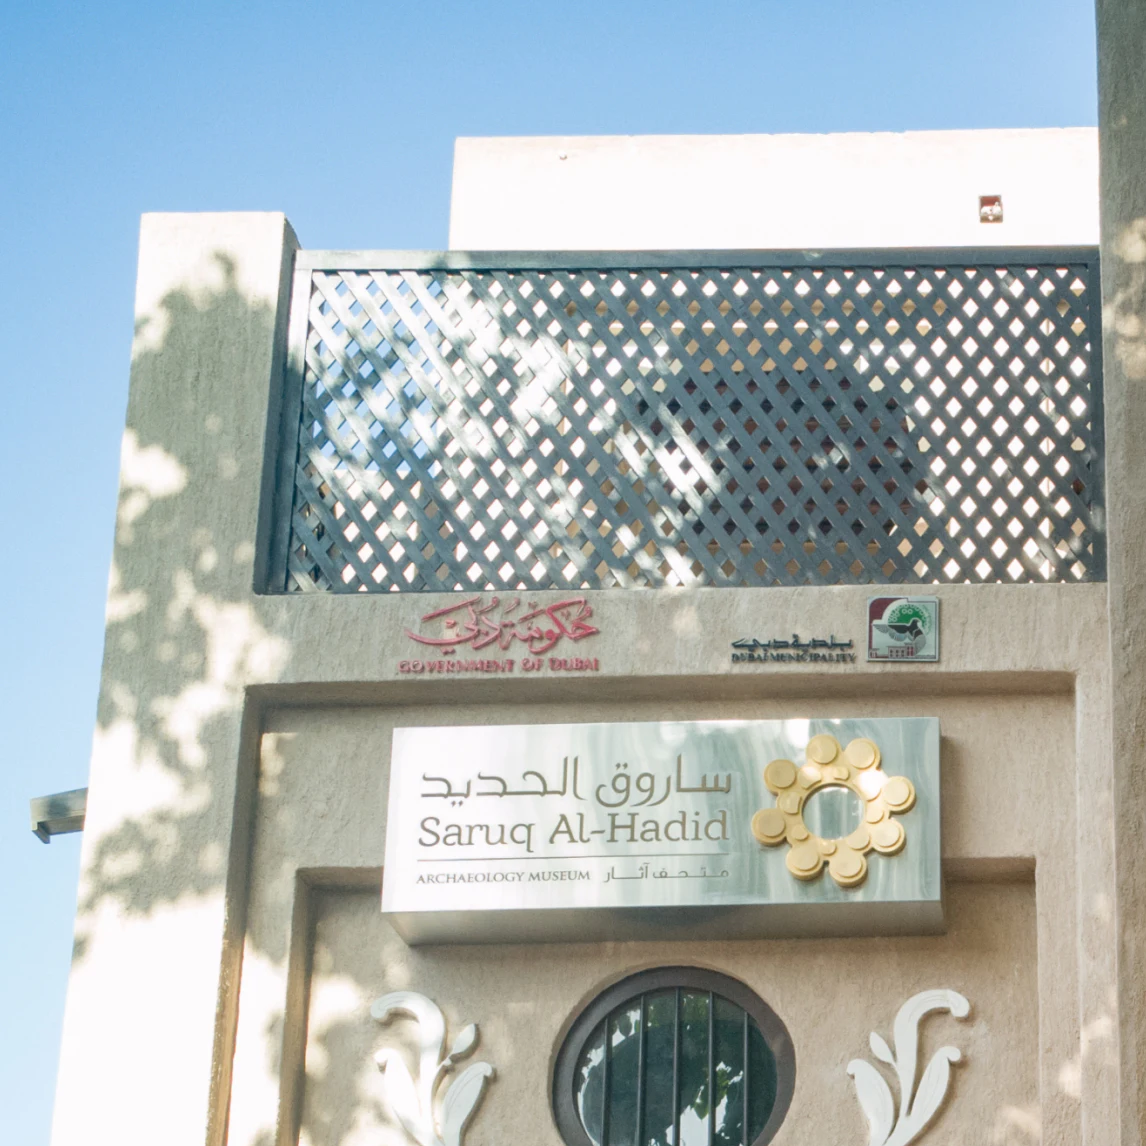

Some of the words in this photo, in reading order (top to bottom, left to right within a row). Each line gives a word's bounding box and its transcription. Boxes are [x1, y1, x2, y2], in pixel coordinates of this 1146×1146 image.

[404, 596, 500, 655] دبي
[500, 596, 599, 654] حكومة
[399, 658, 514, 673] GOVERNMENT
[521, 657, 545, 672] OF
[549, 656, 599, 671] DUBAI
[731, 652, 768, 663] DUBAI
[769, 651, 856, 663] MUNICIPALITY
[420, 755, 588, 807] الحديد
[595, 753, 732, 808] ساروق
[418, 816, 536, 853] Saruq
[549, 810, 730, 845] Al-Hadid
[416, 871, 525, 884] ARCHAEOLOGY
[528, 869, 591, 882] MUSEUM
[603, 862, 651, 884] آثار
[652, 866, 730, 879] متحف
